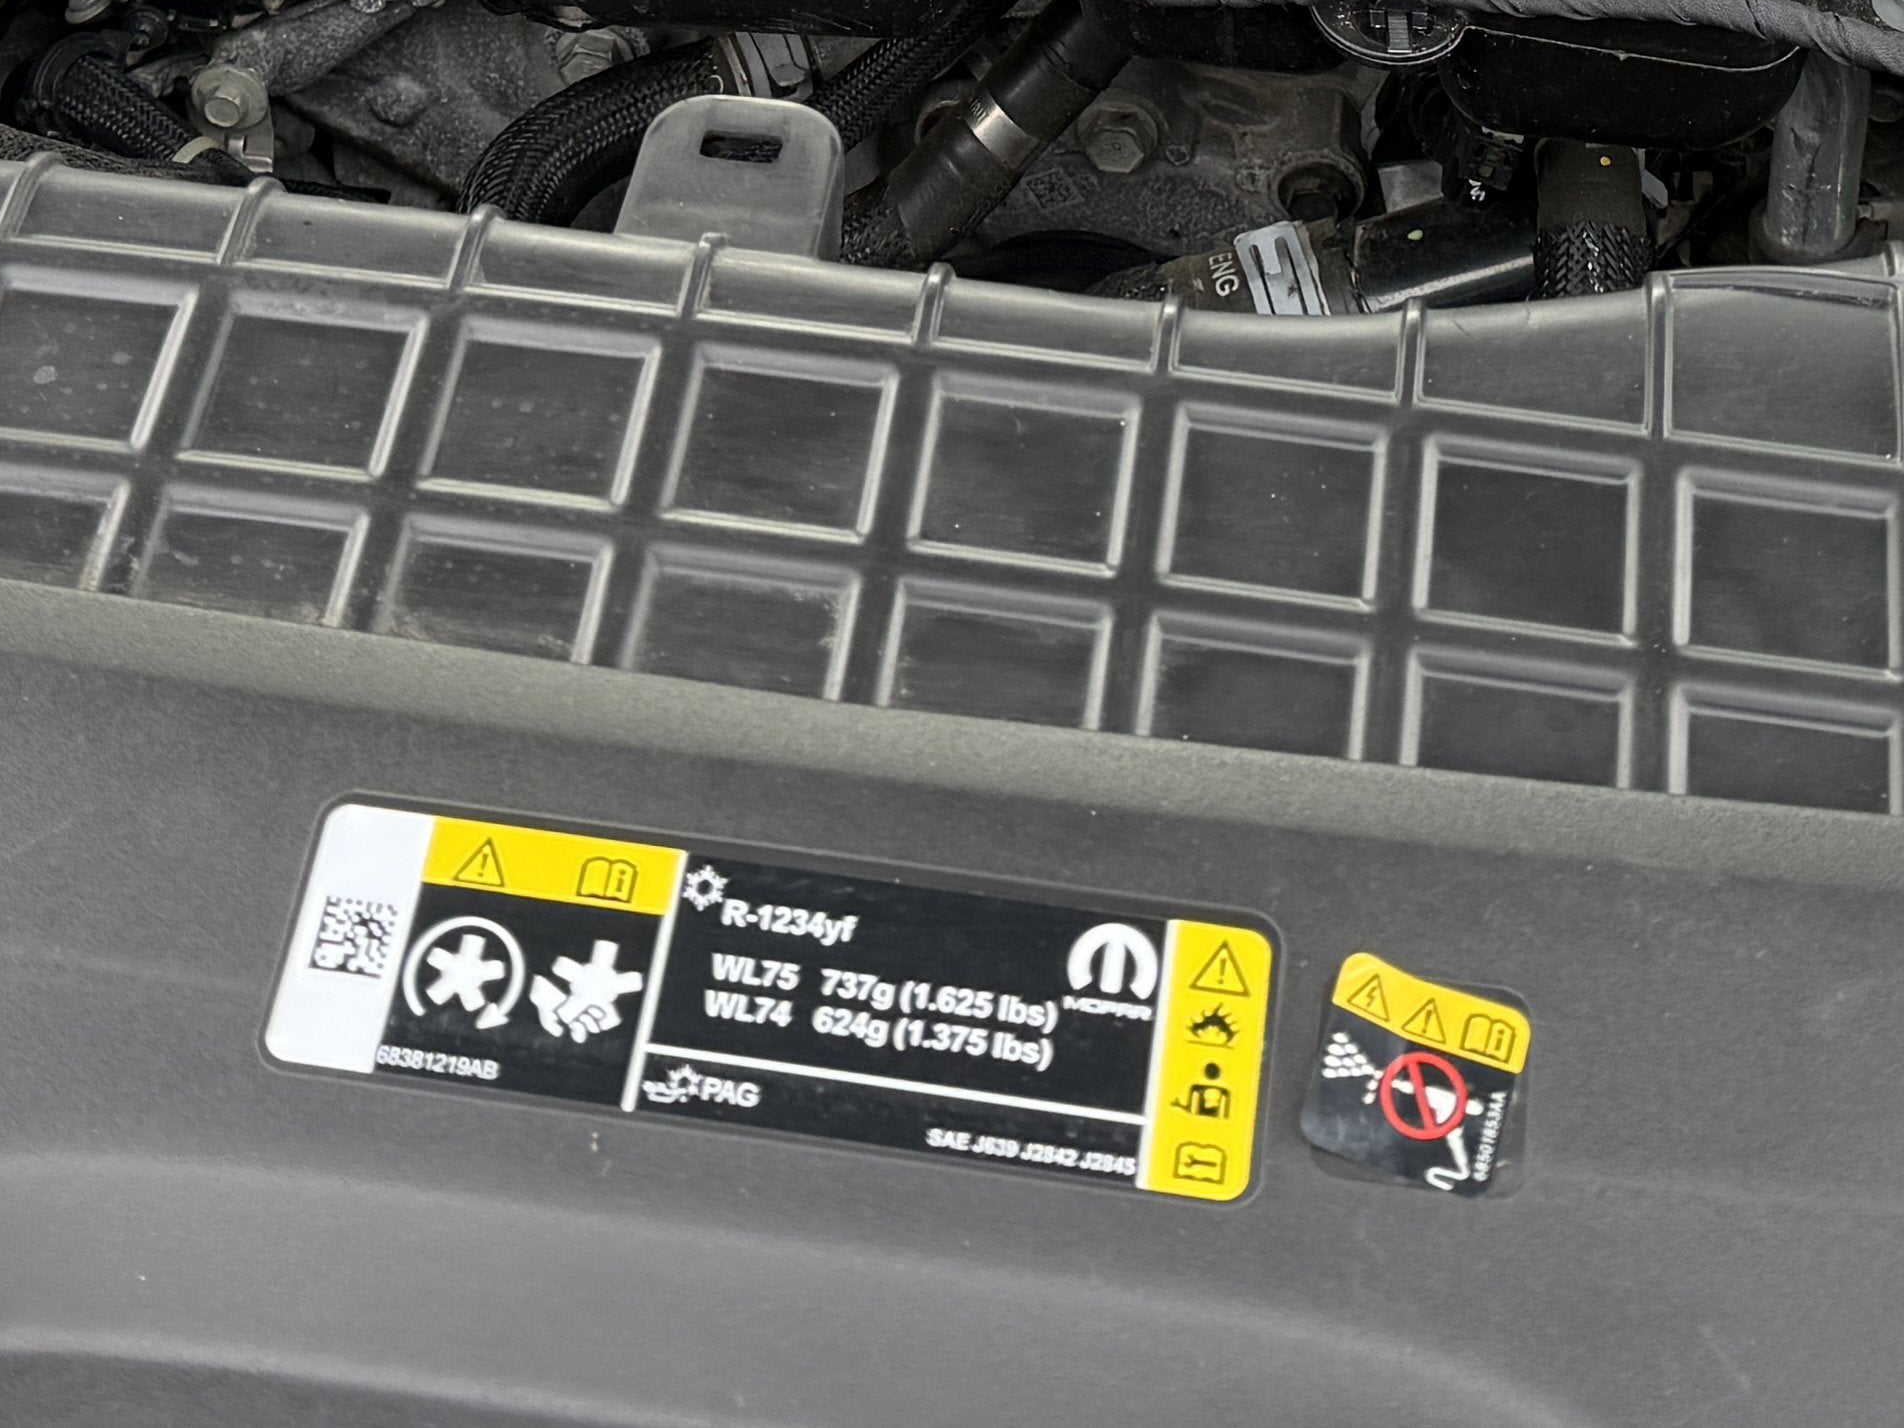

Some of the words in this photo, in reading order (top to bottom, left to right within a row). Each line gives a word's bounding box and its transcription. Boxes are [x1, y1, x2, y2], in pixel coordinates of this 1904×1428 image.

[1208, 252, 1239, 297] ENG
[719, 898, 860, 946] R-1234yf
[711, 952, 801, 991] WL75
[819, 968, 896, 1011] 737g
[899, 980, 994, 1020] (1.625
[997, 993, 1059, 1034] lbs)
[704, 989, 793, 1028] WL74
[811, 1005, 890, 1049] 624g
[892, 1018, 989, 1058] (1.375
[991, 1030, 1054, 1072] lbs)
[376, 1045, 501, 1080] 68381219AB
[700, 1076, 761, 1108] PAG
[926, 1128, 971, 1151] SAE
